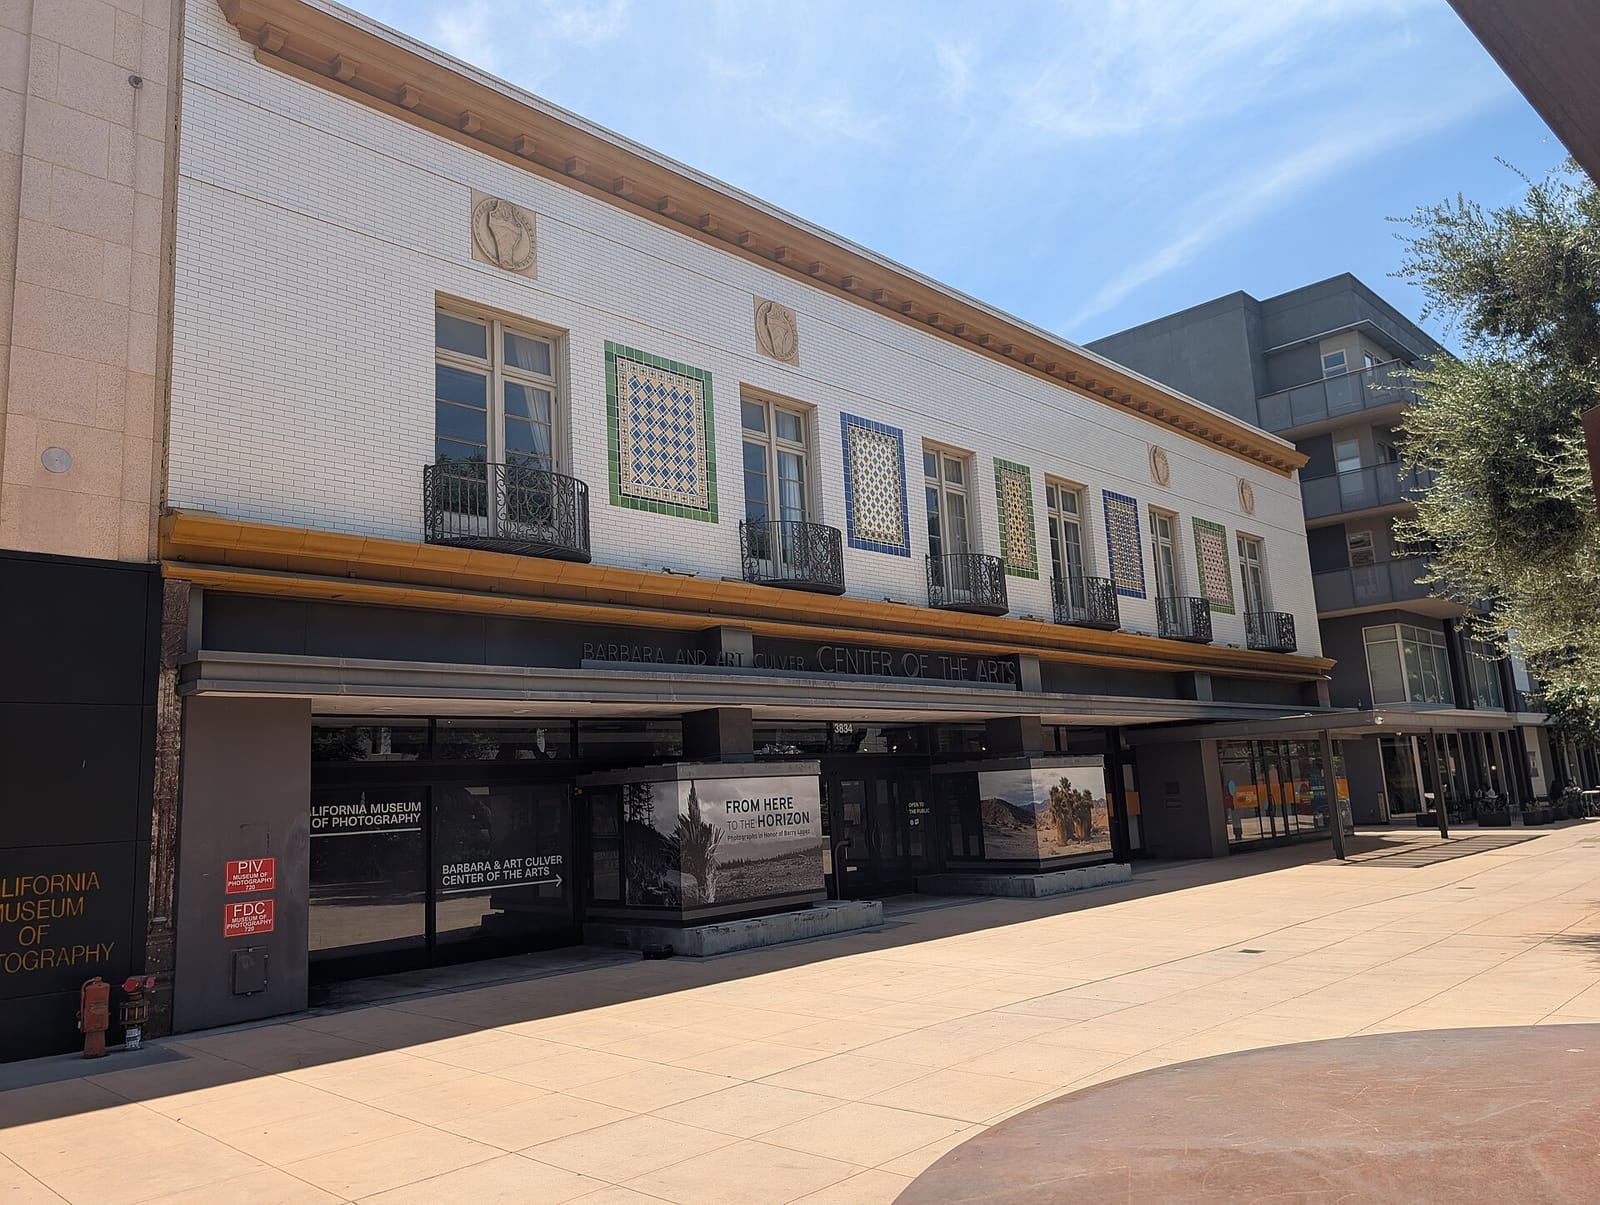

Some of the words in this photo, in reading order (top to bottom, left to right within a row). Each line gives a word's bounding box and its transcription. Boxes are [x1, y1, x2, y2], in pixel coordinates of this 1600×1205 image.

[583, 642, 665, 664] BARBARA
[676, 648, 707, 665] AND
[715, 651, 744, 667] ART
[753, 653, 805, 671] CULVER
[816, 646, 894, 676] CENTER
[901, 653, 928, 678] OF
[938, 656, 968, 681] THE
[976, 660, 1016, 684] ARTS
[834, 723, 853, 733] 3834
[310, 804, 367, 817] LIFORNIA
[370, 801, 422, 814] MUSEUM
[725, 798, 760, 814] FROM
[763, 797, 794, 811] HERE
[311, 817, 329, 828] OF
[332, 813, 421, 828] PHOTOGRAPHY
[727, 820, 737, 830] TO
[739, 819, 755, 830] THE
[757, 811, 810, 828] HORIZON
[238, 859, 263, 874] PIV
[442, 861, 492, 875] BARBARA
[493, 860, 502, 870] &
[503, 858, 523, 870] ART
[525, 855, 563, 867] CULVER
[227, 877, 273, 887] PHOTOGRAPHY
[232, 873, 259, 881] MUSEUM
[442, 873, 485, 886] CENTER
[486, 871, 501, 882] OF
[502, 869, 523, 880] THE
[524, 866, 550, 879] ARTS
[233, 902, 265, 917] FDC
[226, 919, 273, 930] PHOTOGRAPHY
[231, 916, 258, 924] MUSEUM
[18, 924, 50, 947] OF
